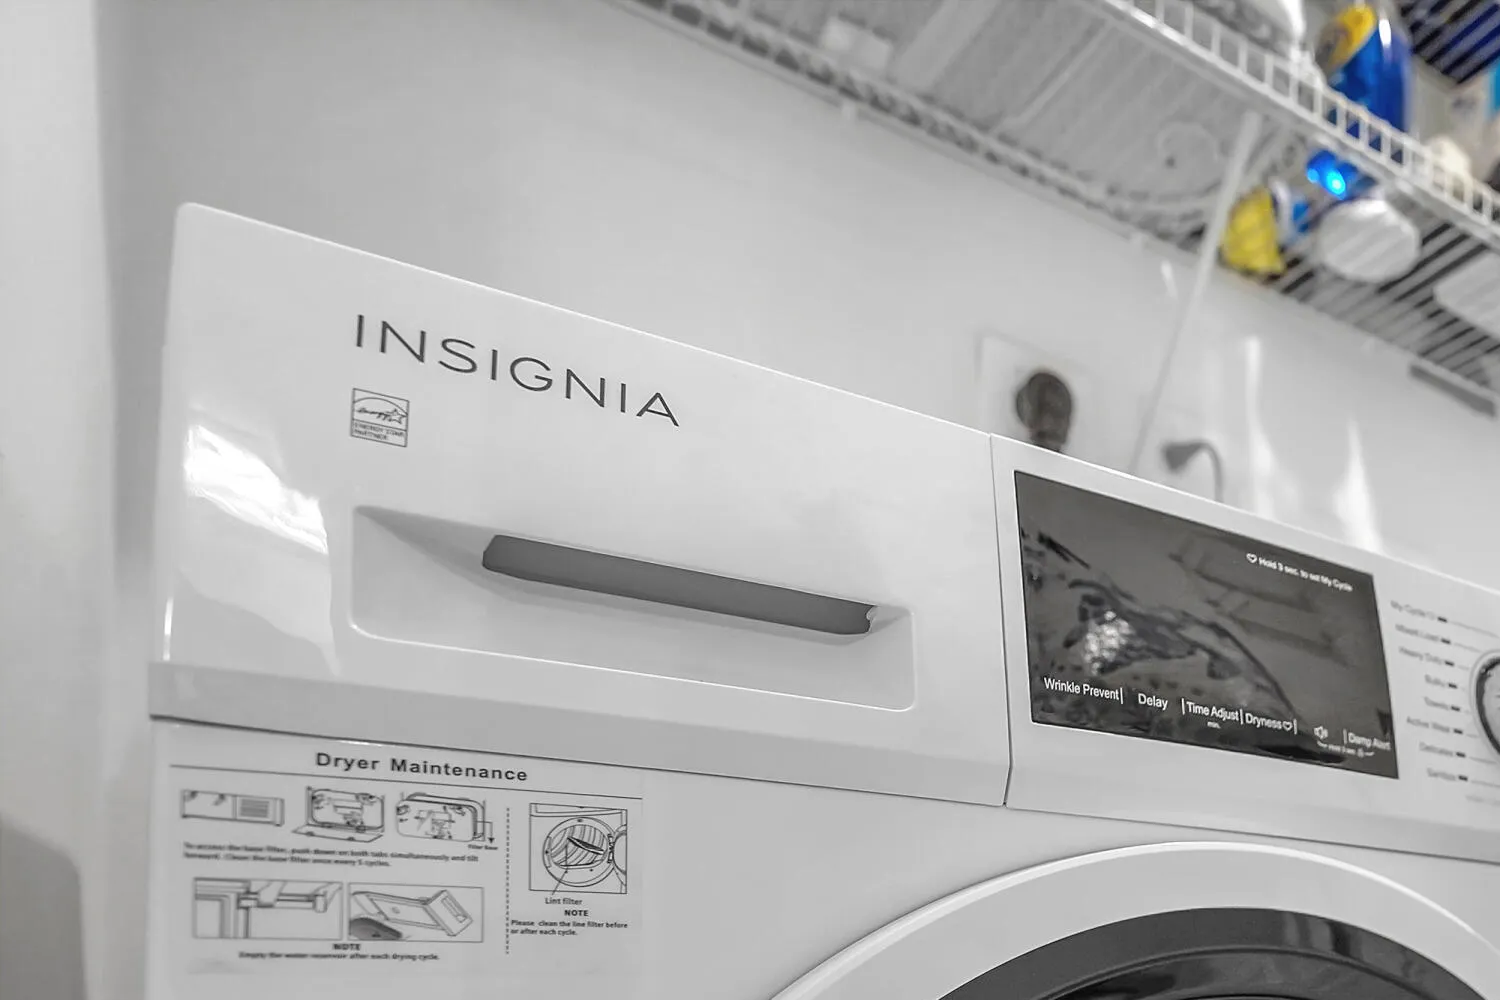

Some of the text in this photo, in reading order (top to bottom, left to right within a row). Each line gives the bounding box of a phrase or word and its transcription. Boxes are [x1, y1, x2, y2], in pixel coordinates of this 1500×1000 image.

[355, 313, 680, 428] INSIGNIA
[1043, 677, 1120, 701] Wrinkle Prevent
[1137, 692, 1169, 711] Delay
[1186, 701, 1240, 722] Time Adjust
[1245, 712, 1283, 730] Dryness
[316, 752, 528, 782] Dryer Maintenance
[544, 897, 583, 906] Lint filter
[564, 909, 589, 917] NOTE
[510, 919, 535, 927] Please
[538, 919, 558, 927] clean
[559, 920, 571, 928] the
[587, 920, 604, 929] filter
[605, 921, 628, 929] before
[520, 928, 538, 936] after
[539, 928, 557, 936] each
[557, 929, 578, 937] cycle.
